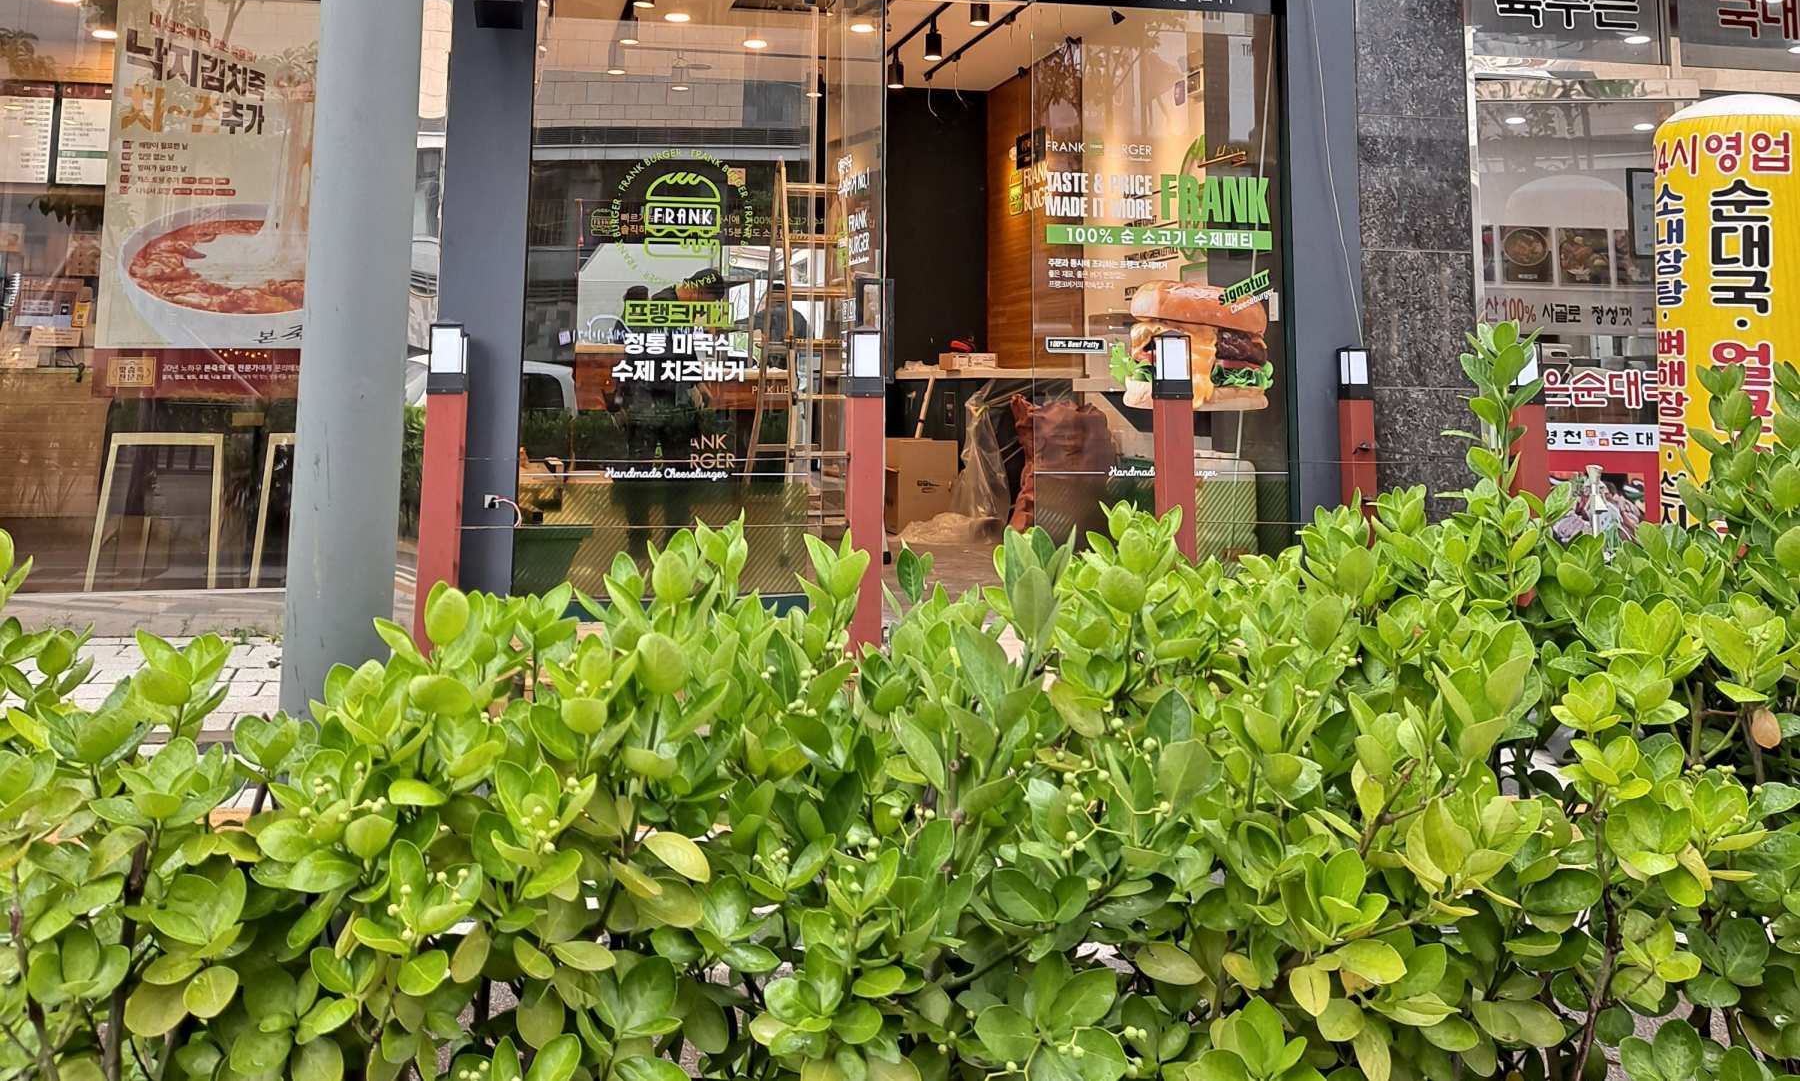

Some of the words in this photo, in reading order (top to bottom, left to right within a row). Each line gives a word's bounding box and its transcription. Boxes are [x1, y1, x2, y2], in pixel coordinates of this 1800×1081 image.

[126, 27, 267, 102] 낙지김치죽
[220, 98, 266, 136] 추가
[1045, 140, 1087, 153] FRANK
[618, 162, 645, 192] FRANK
[643, 148, 681, 167] BURGER
[1046, 171, 1089, 194] TASTE
[1093, 173, 1105, 195] &
[1110, 173, 1153, 196] PRICE
[1045, 197, 1089, 218] MADE
[1093, 197, 1105, 218] IT
[1112, 198, 1153, 220] MORE
[1160, 172, 1271, 224] FRANK
[654, 207, 713, 225] FRANK
[848, 208, 868, 232] FRANK
[848, 231, 870, 255] BURGER
[1066, 227, 1114, 244] 100%
[1120, 228, 1136, 245] 순
[1142, 229, 1188, 246] 소고기
[1194, 230, 1254, 248] 수제패티
[1656, 183, 1689, 306] 소내장탕
[1710, 179, 1772, 314] 순대국
[1218, 272, 1270, 306] signatur
[1502, 297, 1537, 324] 100%
[1542, 303, 1581, 323] 사골로
[1591, 305, 1633, 326] 정성껏
[624, 332, 667, 355] 정통
[673, 332, 736, 357] 미국식
[611, 360, 655, 382] 수제
[660, 360, 745, 382] 치즈버거
[1611, 431, 1654, 446] 순대
[603, 466, 662, 479] Handmade
[664, 466, 729, 481] Cheeseburger
[1108, 466, 1155, 477] Handmad
